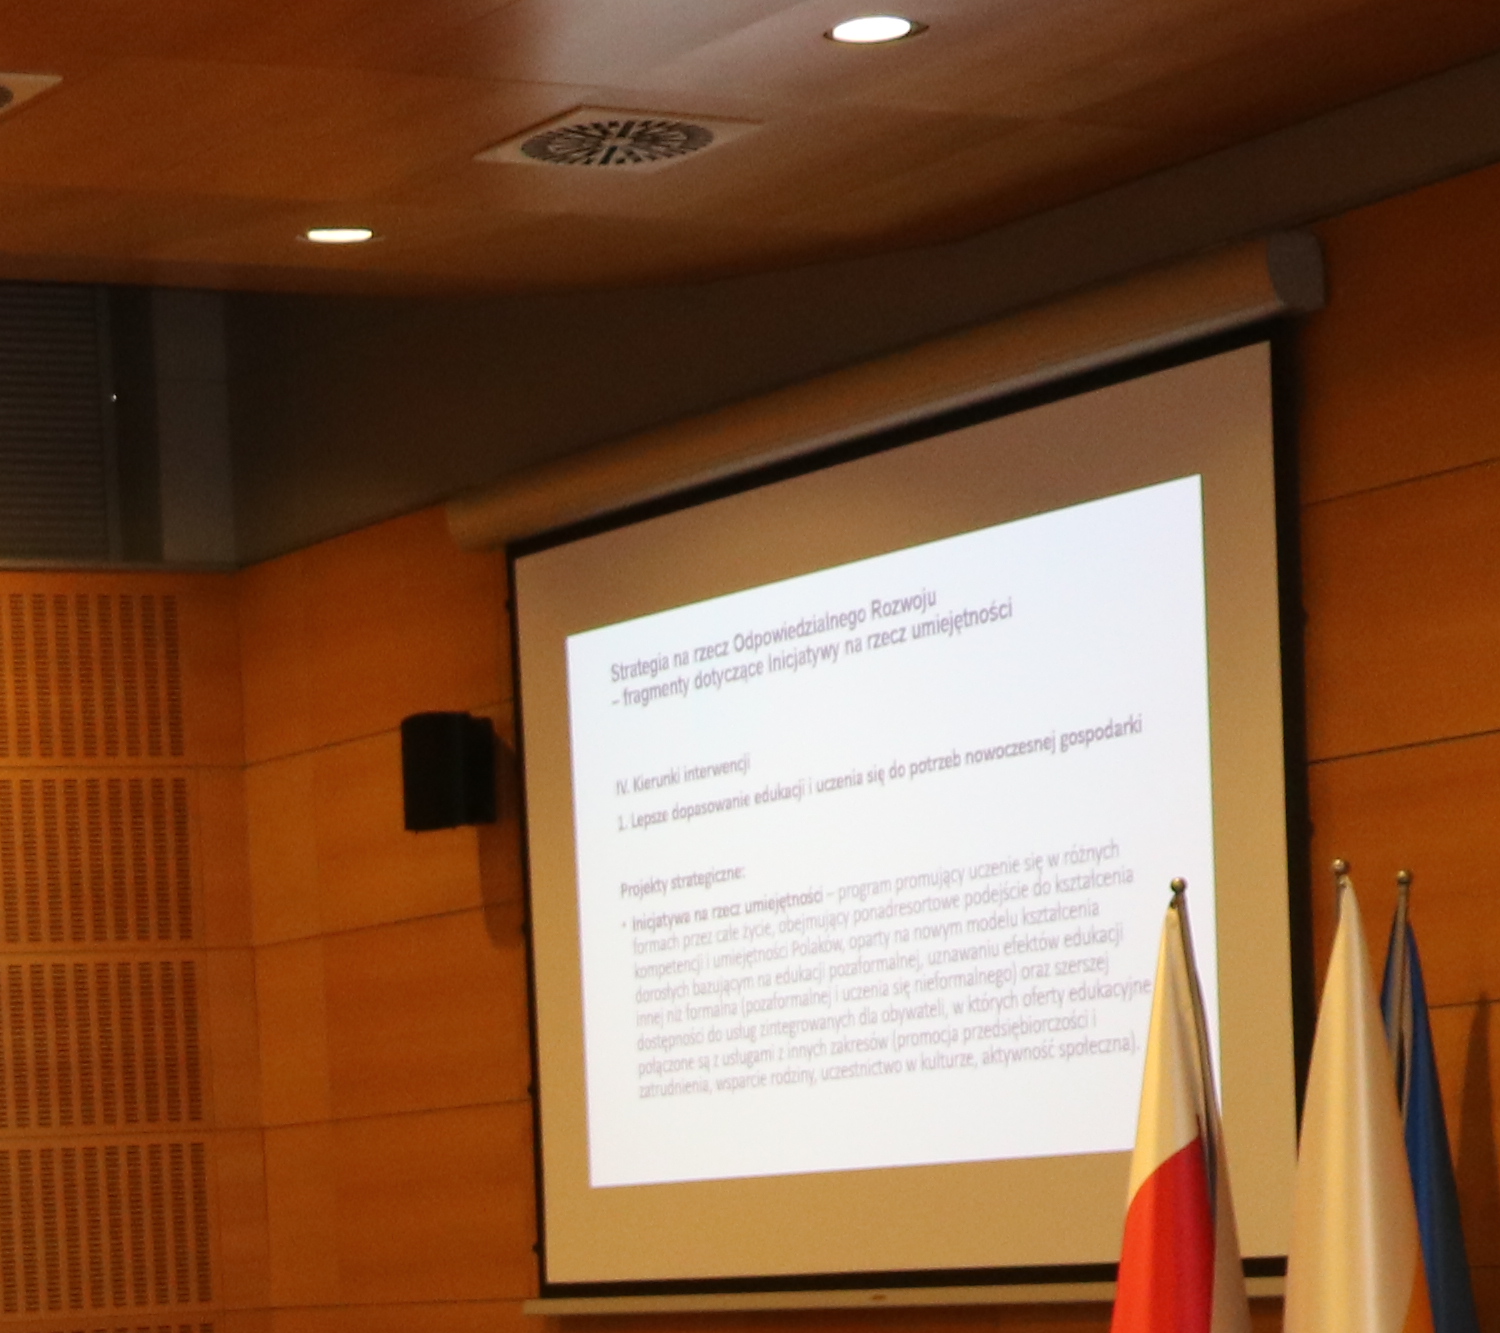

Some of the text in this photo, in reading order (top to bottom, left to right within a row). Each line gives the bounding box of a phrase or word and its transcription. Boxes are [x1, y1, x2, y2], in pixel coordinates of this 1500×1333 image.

[609, 586, 937, 684] Strategia na rzecz Odpowiedzialnego Rozwoju
[621, 674, 690, 708] fragmenty
[692, 659, 764, 691] dotyczące
[766, 641, 840, 673] Inicjatywy
[843, 636, 863, 656] na
[865, 625, 908, 651] rzecz
[910, 595, 1013, 641] umiejętności
[629, 808, 669, 831] Lepsze
[670, 792, 751, 823] dopasowanie
[752, 778, 806, 806] edukacji
[814, 771, 864, 794] uczenia
[865, 767, 886, 787] się
[887, 759, 906, 781] do
[907, 747, 962, 781] potrzeb
[963, 733, 1057, 765] nowoczesnej
[1058, 712, 1143, 754] gospodarki
[631, 766, 681, 793] Kierunki
[682, 752, 751, 783] interwencji
[618, 865, 745, 901] Projekty strategiczne:
[631, 910, 692, 934] Inicjatywa
[692, 907, 709, 922] na
[710, 901, 742, 920] rzecz
[743, 889, 824, 915] umiejętności
[836, 878, 892, 905] program
[893, 867, 965, 896] promujący
[967, 857, 1021, 881] uczenie
[1022, 854, 1044, 878] się
[1062, 837, 1120, 866] różnych
[631, 932, 680, 955] formach
[681, 930, 713, 952] przez
[714, 923, 739, 944] całe
[777, 910, 850, 936] obejmujący
[851, 893, 961, 927] ponadresortowe
[962, 882, 1029, 912] podejście
[1031, 873, 1052, 898] do
[1053, 867, 1134, 894] kształcenia
[632, 957, 703, 980] kompetencji
[711, 944, 789, 969] umiejętności
[847, 929, 891, 953] oparty
[892, 927, 910, 943] na
[912, 920, 963, 942] nowym
[965, 908, 1019, 933] modelu
[1020, 900, 1100, 926] kształcenia
[633, 980, 690, 1005] dorosłych
[691, 974, 754, 999] bazującym
[756, 972, 772, 988] na
[773, 964, 825, 986] edukacji
[926, 942, 1000, 967] uznawaniu
[1001, 932, 1060, 957] efektów
[1061, 922, 1124, 949] edukacji
[635, 1011, 664, 1029] innej
[665, 1007, 683, 1023] niż
[683, 994, 738, 1021] formalna
[739, 987, 832, 1019] (pozaformalnej
[841, 981, 890, 1003] uczenia
[891, 979, 911, 1000] się
[913, 960, 1018, 993] nieformalnego)
[1019, 961, 1051, 981] oraz
[1053, 955, 1110, 977] szerszej
[635, 1030, 705, 1054] dostępności
[706, 1024, 723, 1044] do
[724, 1022, 758, 1044] usług
[758, 1008, 856, 1040] zintegrowanych
[857, 1005, 879, 1027] dla
[966, 988, 1019, 1015] których
[1020, 984, 1065, 1009] oferty
[1066, 978, 1152, 1003] edukacyjne
[636, 1056, 695, 1080] połączone
[696, 1054, 711, 1073] są
[721, 1047, 775, 1070] usługami
[786, 1037, 827, 1062] innych
[829, 1035, 889, 1056] zakresów
[891, 1026, 959, 1053] (promocja
[961, 1008, 1089, 1046] przedsiębiorczości
[714, 1072, 767, 1093] wsparcie
[819, 1058, 903, 1082] uczestnictwo
[980, 1037, 1055, 1068] aktywność
